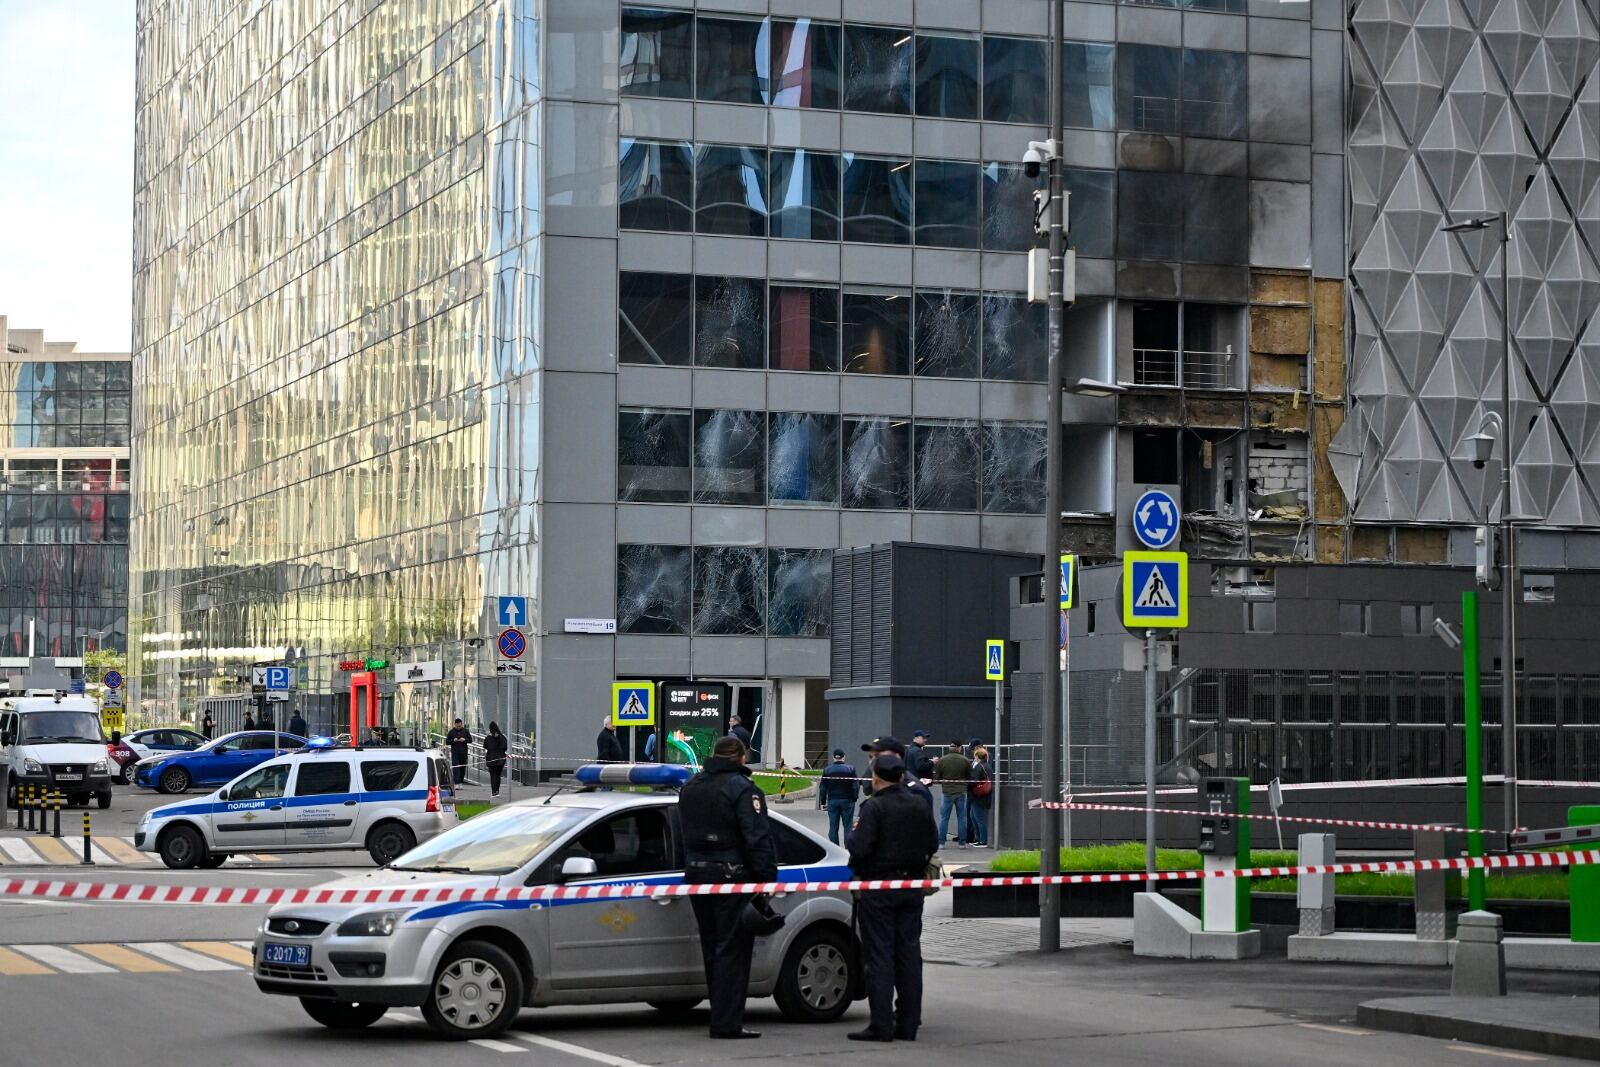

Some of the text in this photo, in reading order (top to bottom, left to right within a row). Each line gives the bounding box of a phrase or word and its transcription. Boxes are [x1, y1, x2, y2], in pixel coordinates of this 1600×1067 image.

[271, 669, 284, 686] P
[700, 708, 719, 716] 25%
[227, 801, 265, 810] ПОЛИЦИЯ
[273, 946, 293, 961] 2017
[297, 947, 306, 958] 99
